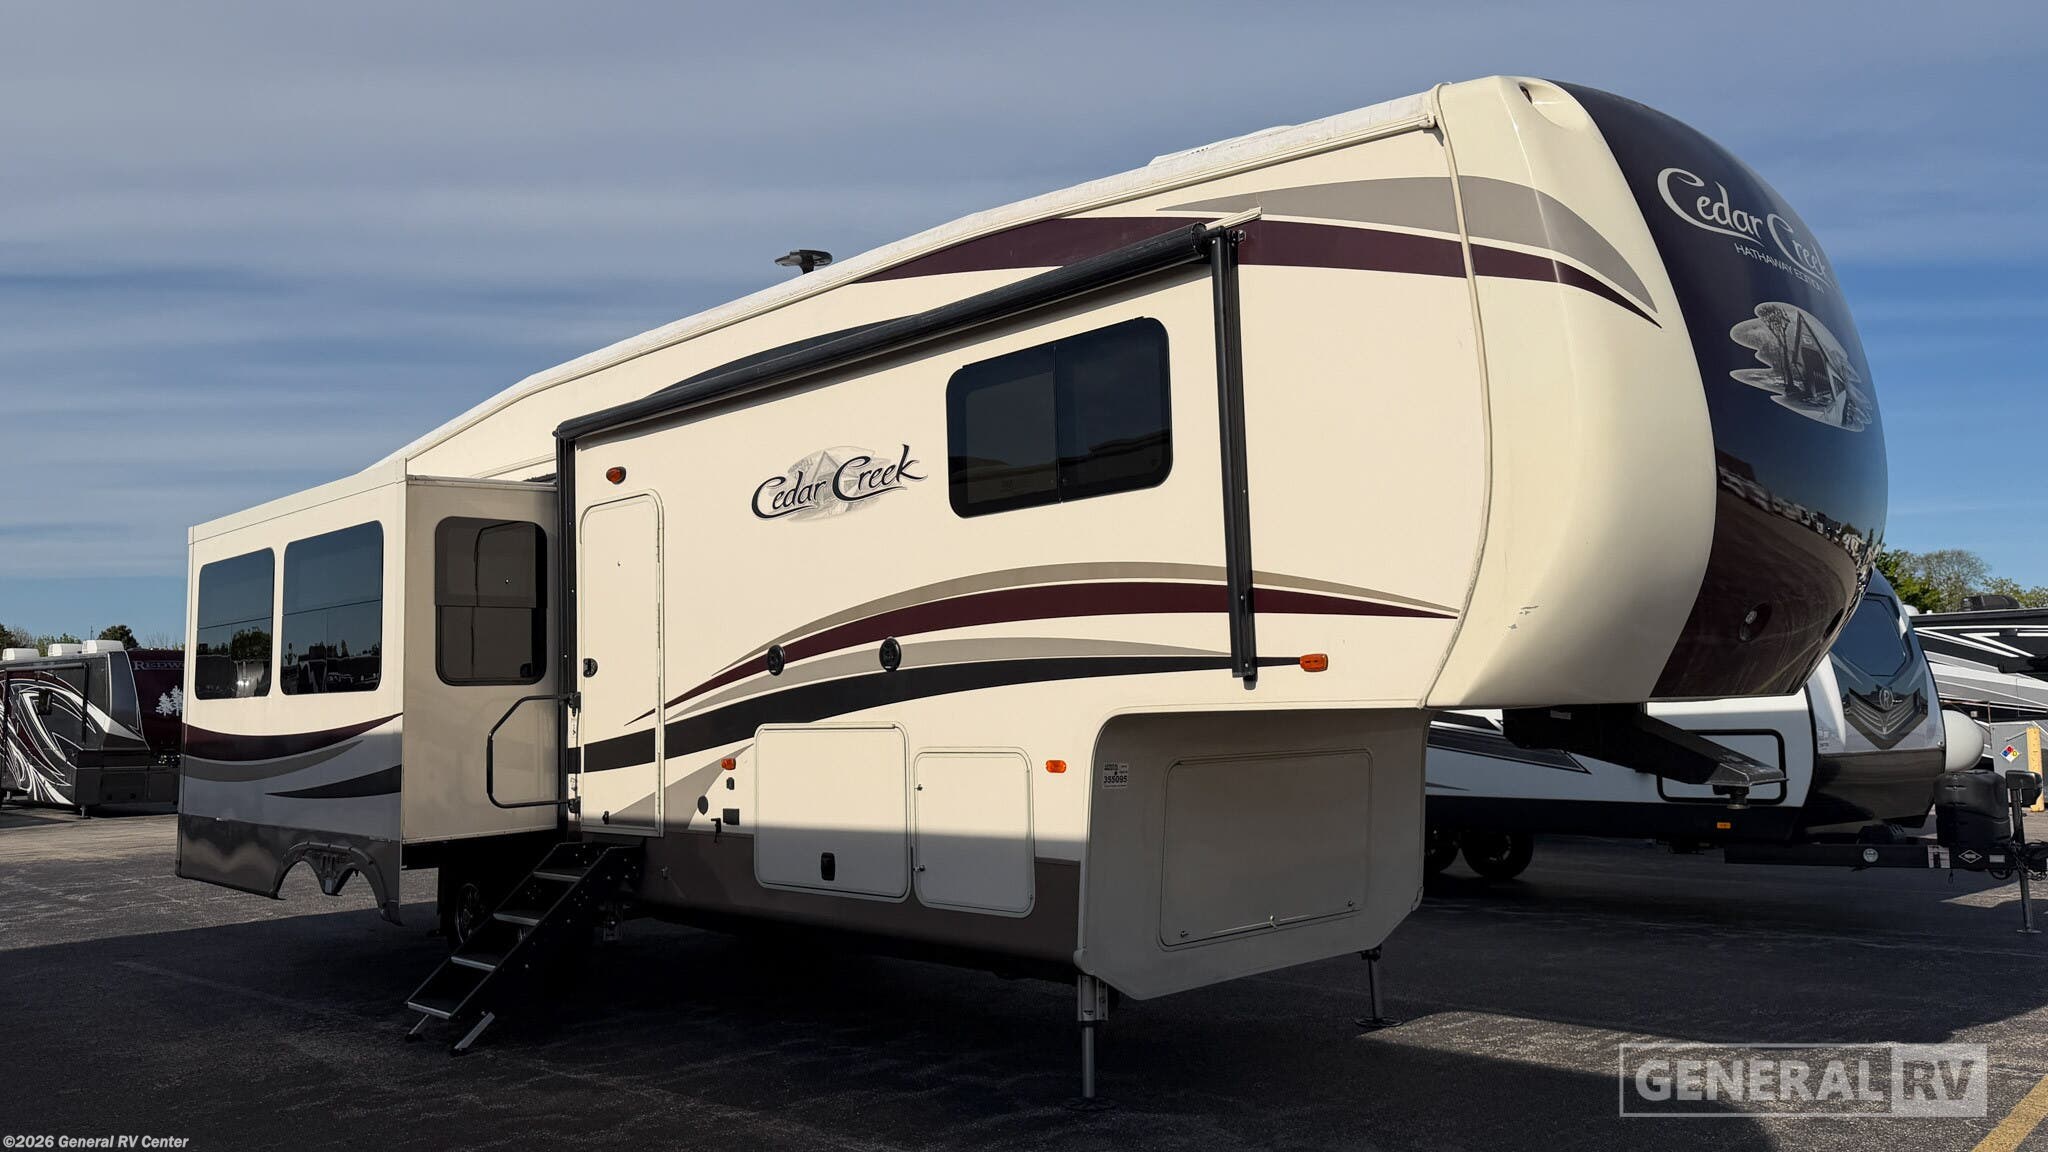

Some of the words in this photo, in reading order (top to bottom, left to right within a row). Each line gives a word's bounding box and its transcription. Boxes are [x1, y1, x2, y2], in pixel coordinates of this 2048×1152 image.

[1657, 167, 1765, 248] Cedar
[1766, 213, 1836, 289] Creek
[1734, 242, 1794, 275] HATHAWAY
[751, 470, 827, 519] Cedar
[832, 444, 928, 501] Creek
[133, 660, 185, 670] REDW
